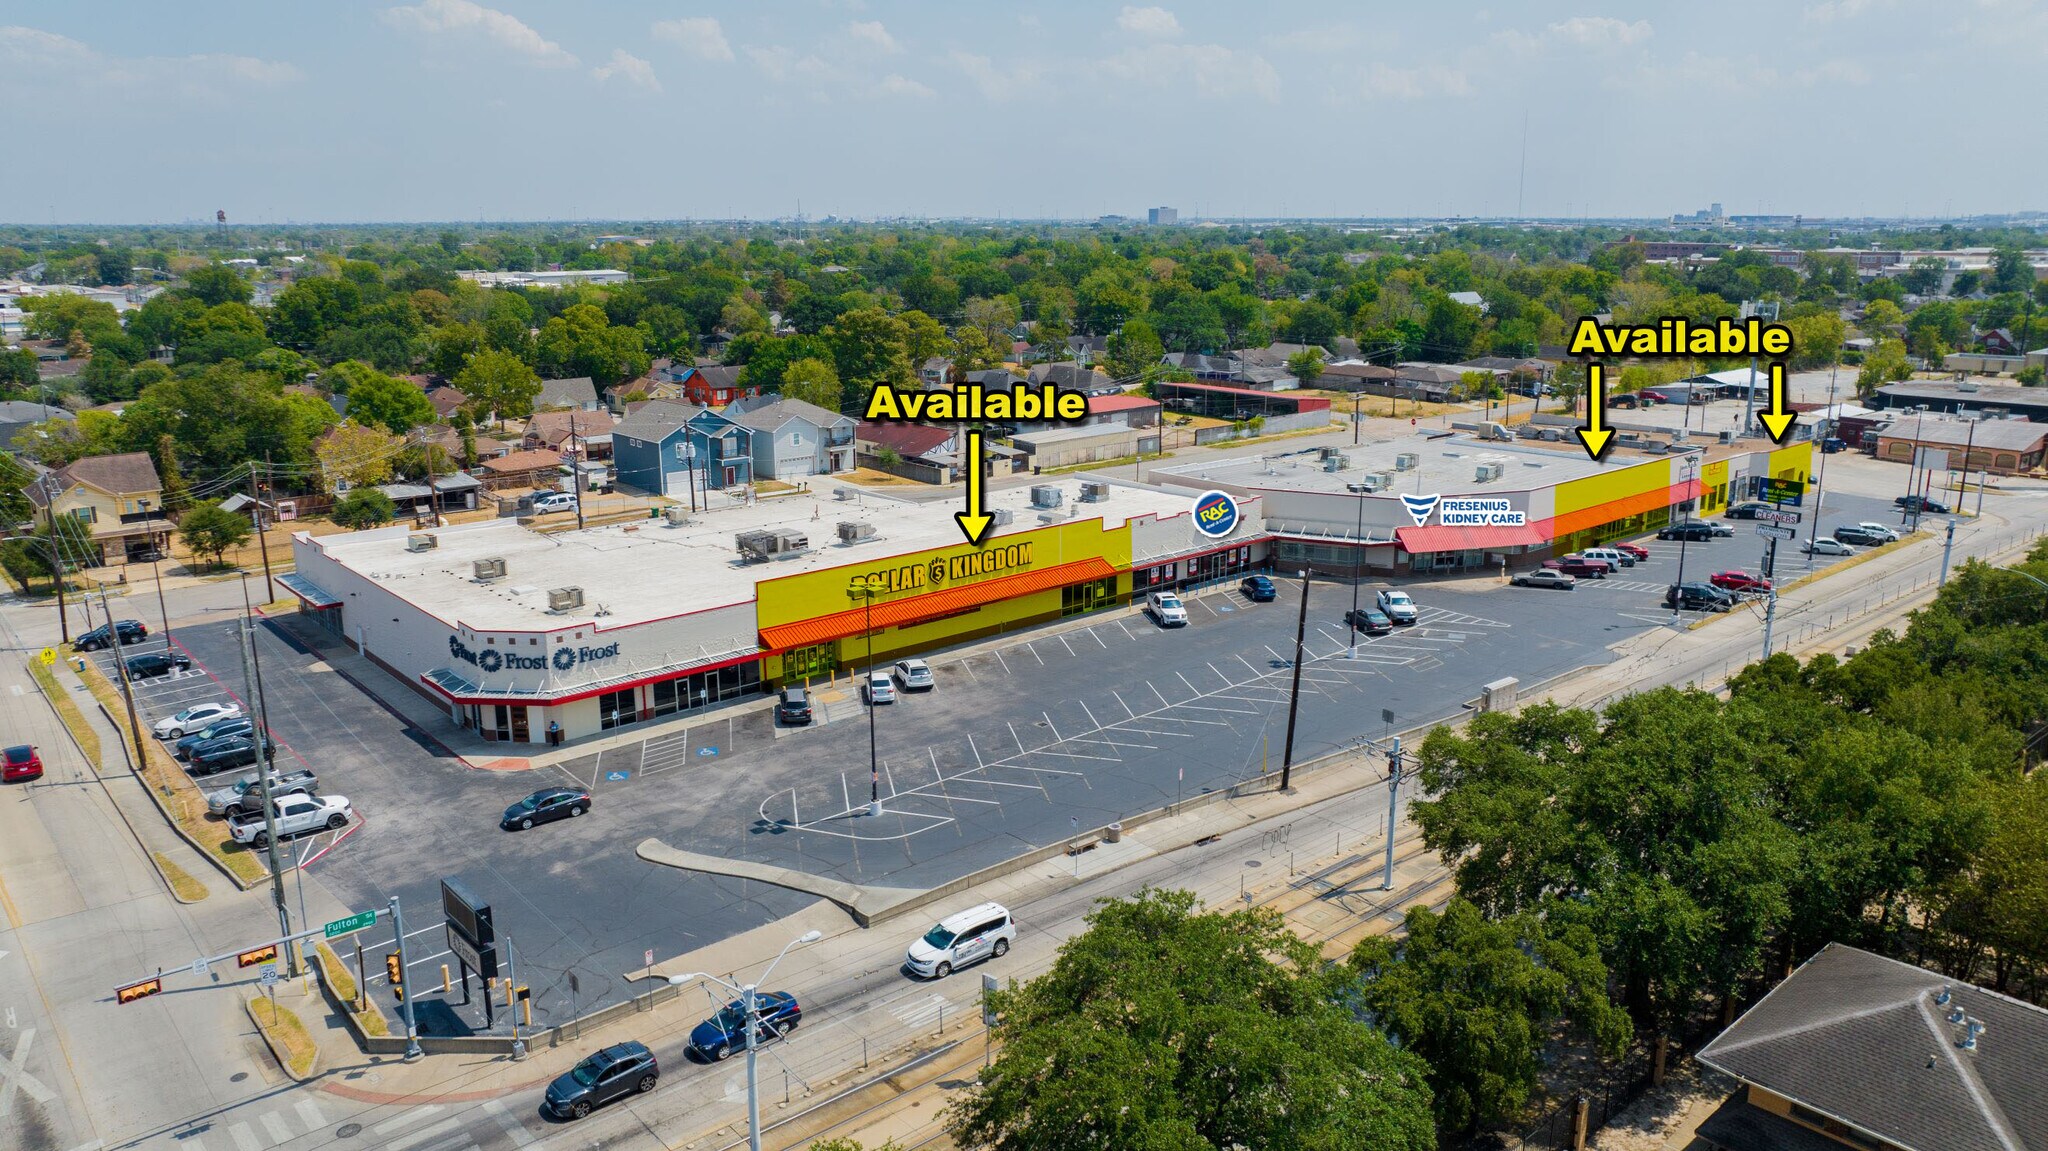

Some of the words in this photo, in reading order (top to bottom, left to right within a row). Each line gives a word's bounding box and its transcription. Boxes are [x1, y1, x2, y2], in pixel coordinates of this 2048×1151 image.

[1199, 501, 1229, 523] RAC
[1443, 501, 1508, 511] FRESENIUS
[1443, 513, 1488, 524] KIDNEY
[1491, 513, 1523, 524] CARE
[1756, 511, 1797, 524] CLEANERS
[950, 541, 1033, 580] KINGDOM
[578, 641, 621, 664] Frost
[504, 653, 549, 670] Frost
[327, 917, 358, 932] Fulton
[262, 970, 276, 980] 20
